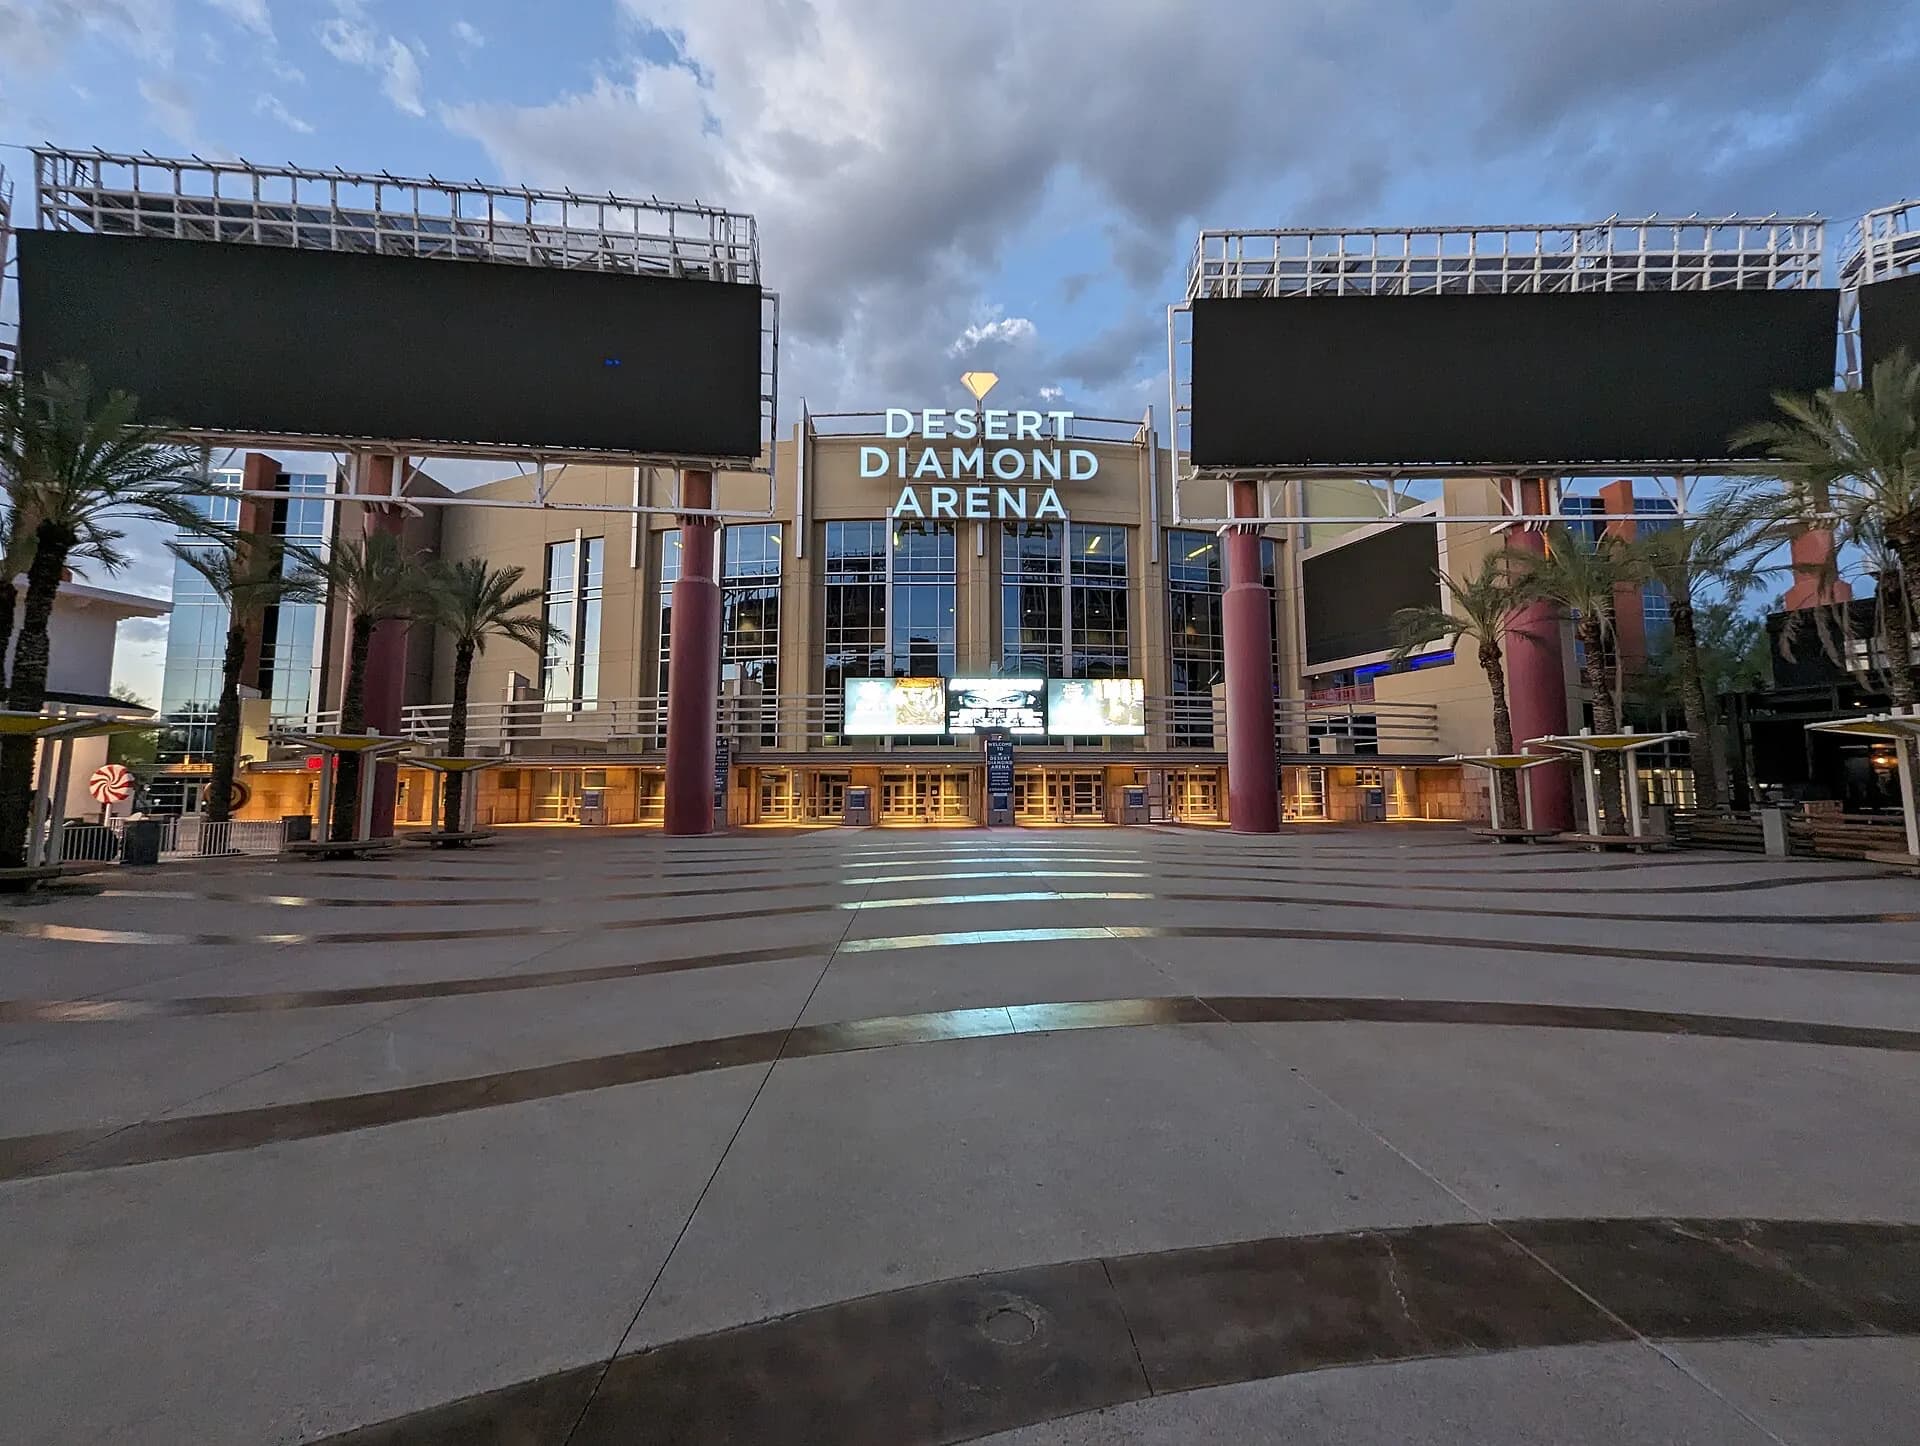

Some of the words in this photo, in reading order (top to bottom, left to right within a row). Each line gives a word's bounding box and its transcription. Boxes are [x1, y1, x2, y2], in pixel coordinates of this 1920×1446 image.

[886, 408, 1074, 440] DESERT
[860, 447, 1099, 481] DIAMOND
[893, 487, 1067, 519] ARENA
